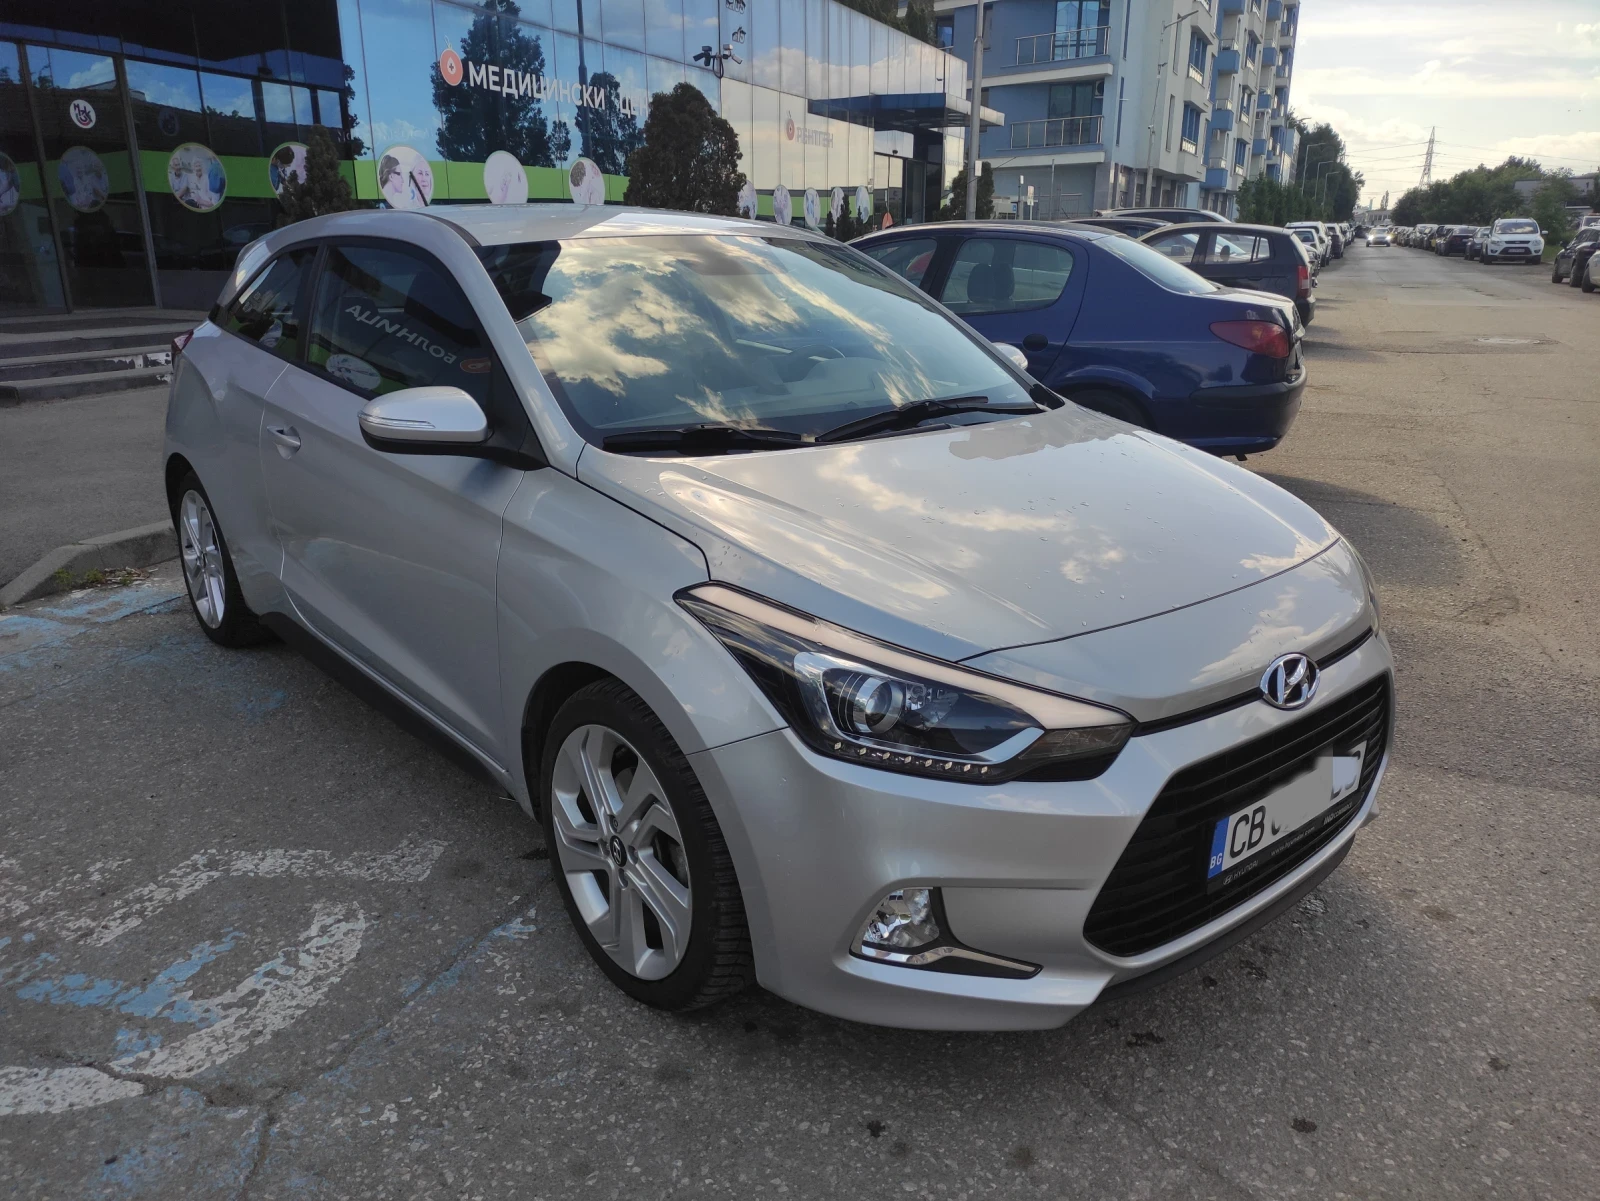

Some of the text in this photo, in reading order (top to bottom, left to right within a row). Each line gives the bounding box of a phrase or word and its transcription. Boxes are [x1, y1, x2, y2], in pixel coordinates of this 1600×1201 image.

[468, 61, 649, 119] МЕДИЦИНСКИ ЦЕН
[1210, 852, 1223, 869] BG
